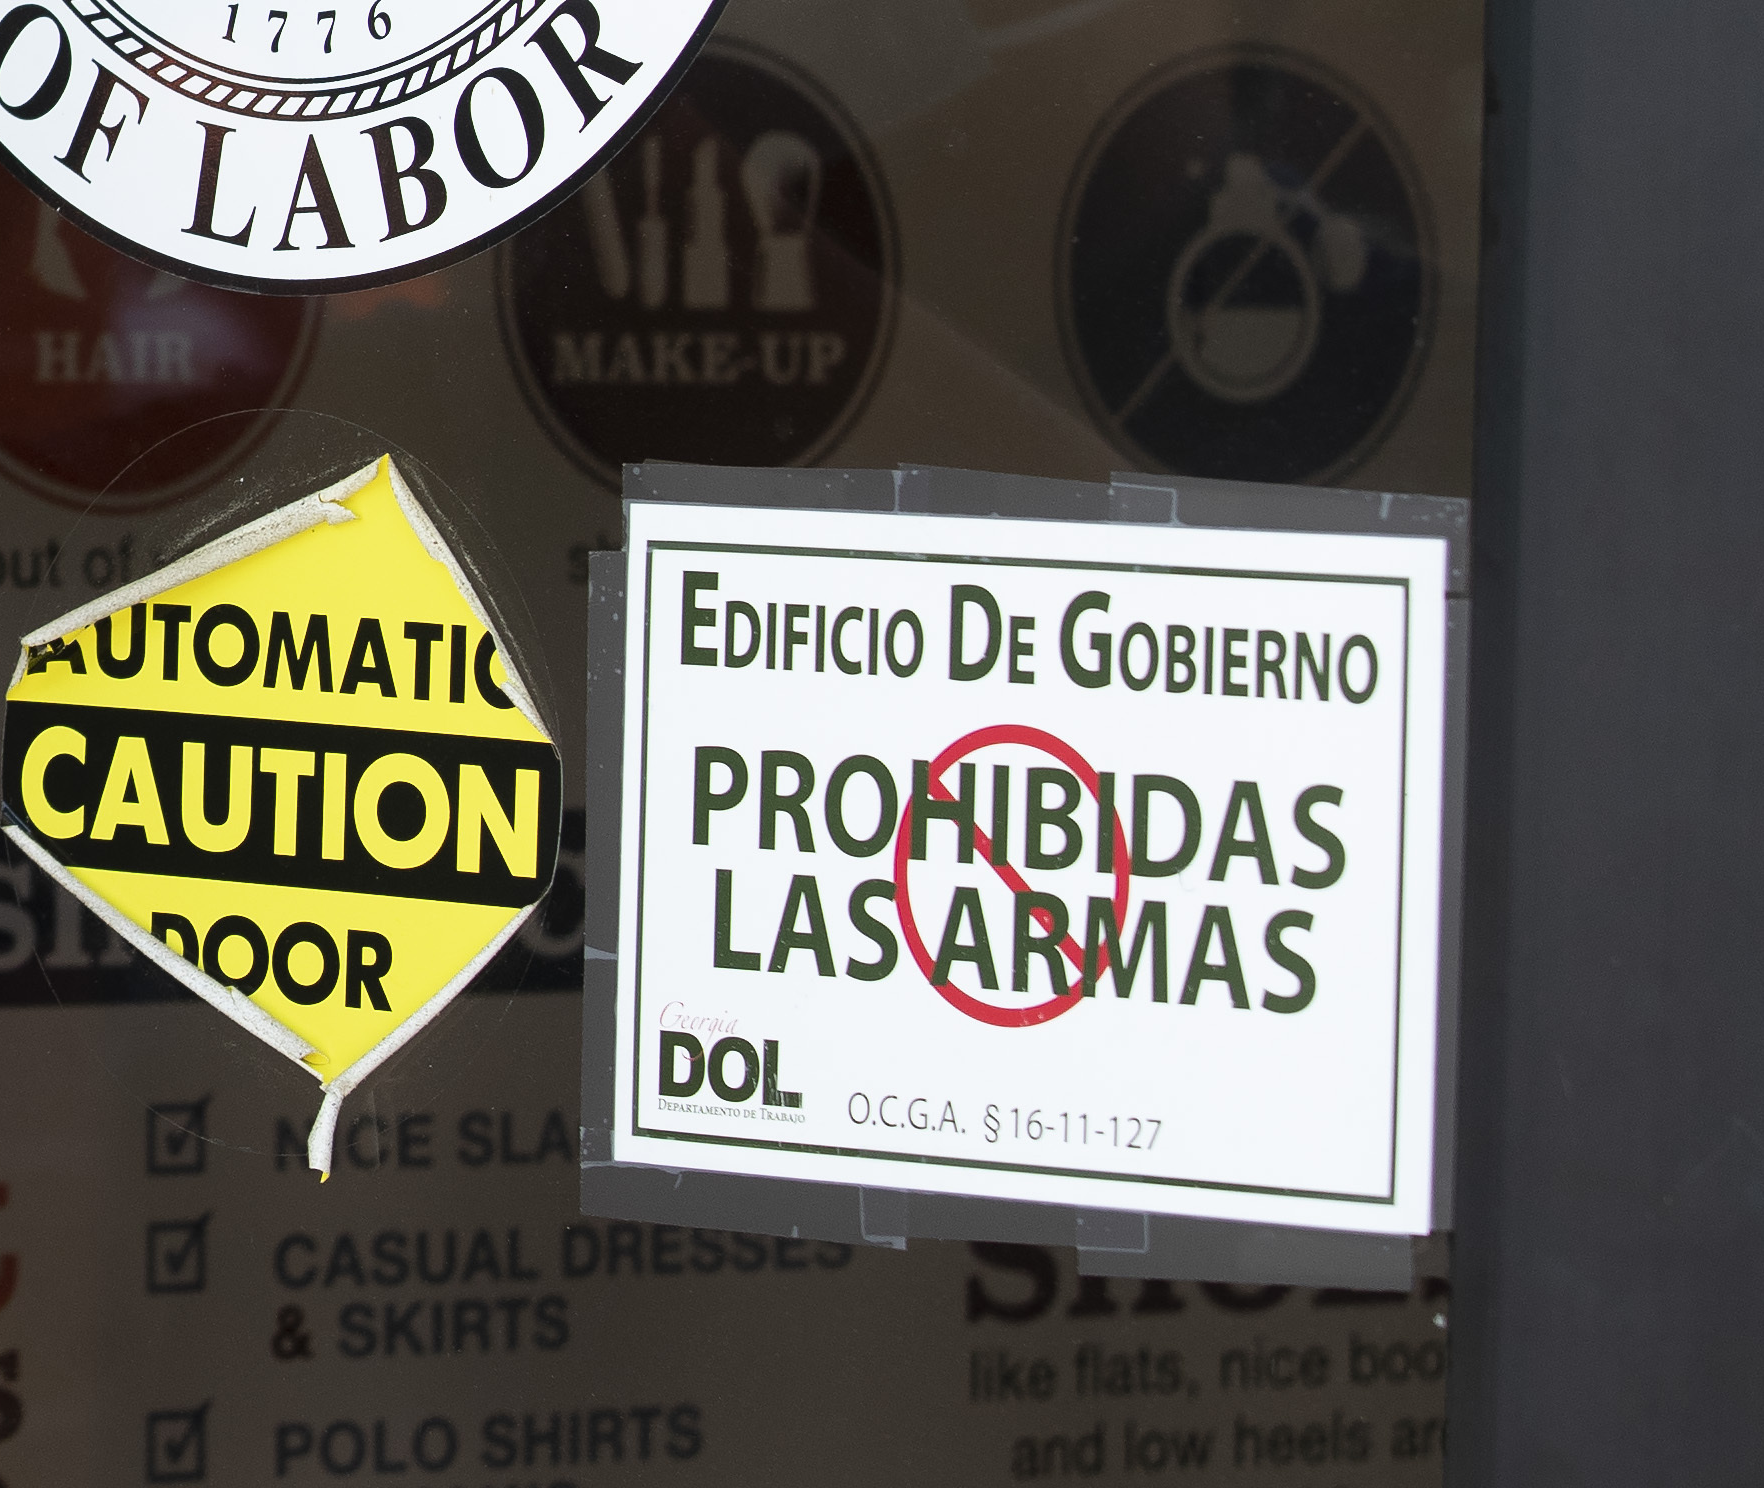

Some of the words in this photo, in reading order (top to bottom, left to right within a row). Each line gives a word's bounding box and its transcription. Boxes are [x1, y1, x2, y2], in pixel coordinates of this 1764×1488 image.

[36, 331, 195, 388] HAIR
[554, 330, 848, 388] MAKE-UP
[20, 724, 541, 879] CAUTION
[690, 745, 1347, 891] PROHIBIDAS
[151, 910, 393, 1012] DOOR
[711, 868, 901, 982] LAS
[929, 885, 1318, 1015] ARMAS
[659, 1001, 741, 1057] Georgia
[658, 1029, 803, 1109] DOL
[460, 1109, 580, 1169] SLA
[848, 1091, 966, 1134] O.C.G.A.
[273, 1225, 539, 1290] CASUAL
[273, 1307, 314, 1362] &
[338, 1294, 570, 1359] SKIRTS
[969, 1348, 1055, 1404] like
[1218, 1333, 1329, 1390] nice
[1348, 1332, 1448, 1386] boo
[275, 1416, 458, 1478] POLO
[482, 1402, 703, 1466] SHIRTS
[1011, 1429, 1105, 1483] and
[1123, 1424, 1211, 1473] low
[1233, 1414, 1373, 1469] heels
